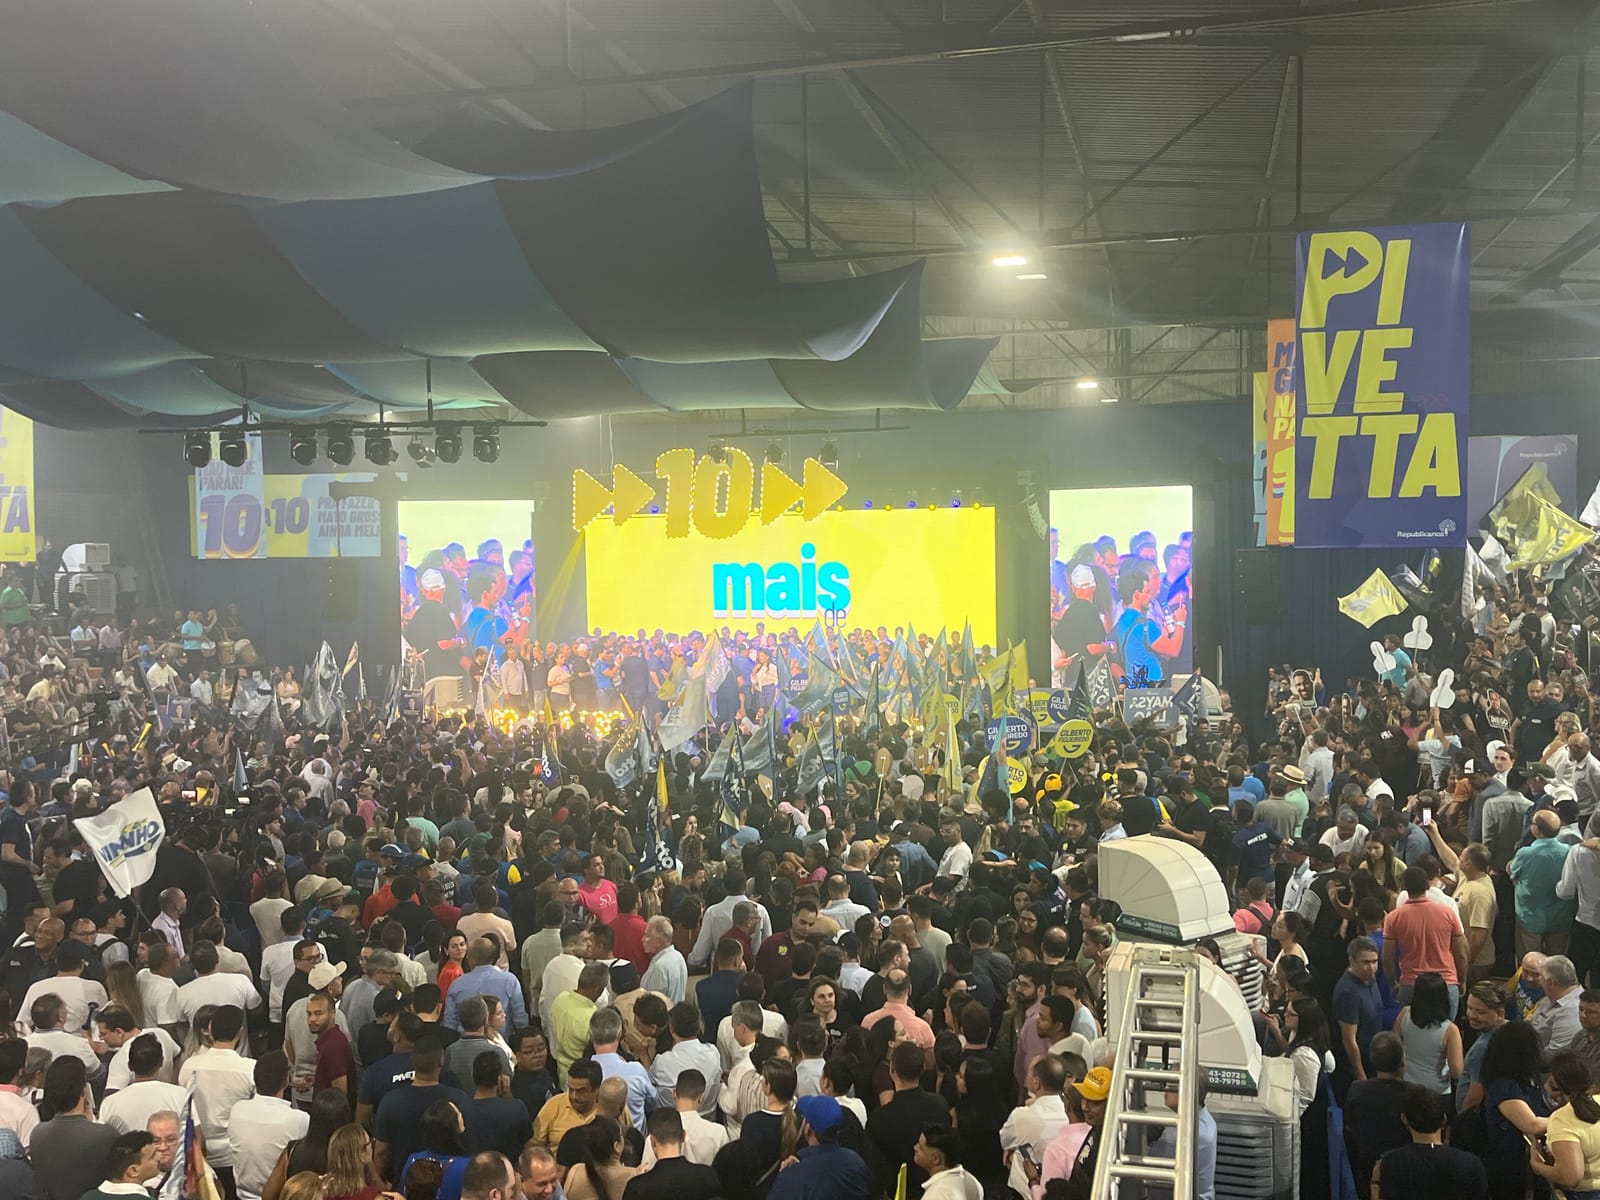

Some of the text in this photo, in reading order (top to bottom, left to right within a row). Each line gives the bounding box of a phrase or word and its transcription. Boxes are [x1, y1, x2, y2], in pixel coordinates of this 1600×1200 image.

[1300, 231, 1412, 329] PI
[1301, 328, 1414, 415] VE
[656, 446, 754, 539] 10
[1301, 412, 1461, 500] TTA
[200, 493, 263, 557] 10
[272, 498, 309, 534] 10
[1396, 530, 1445, 539] Republicanos
[713, 542, 852, 619] mais
[823, 601, 847, 627] de
